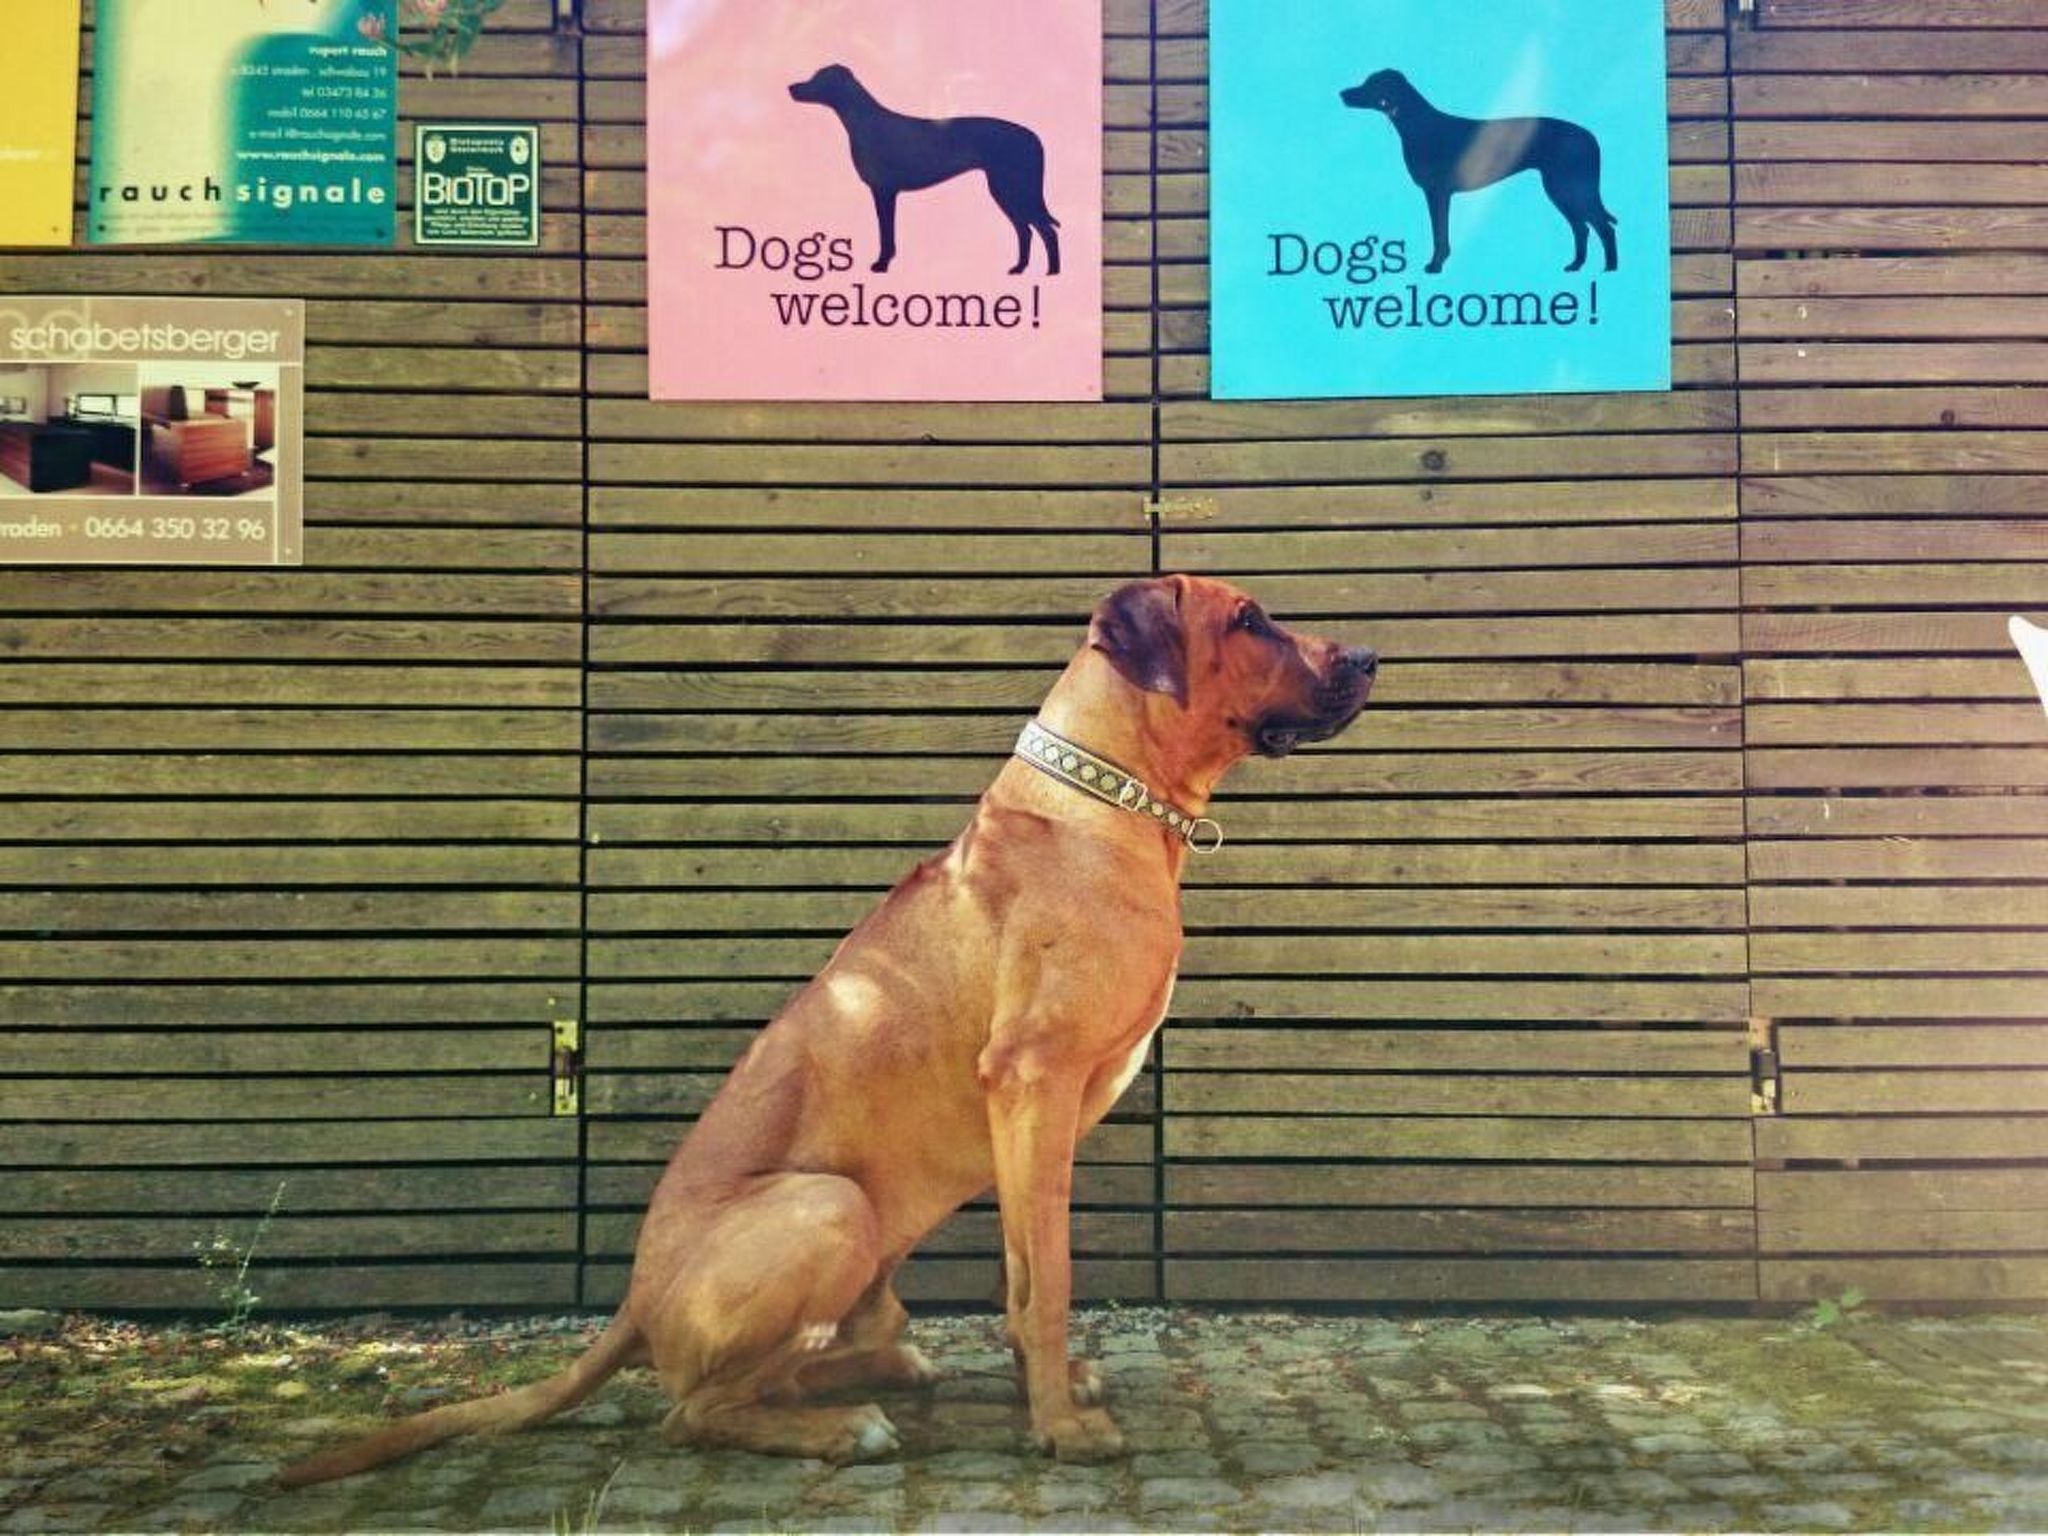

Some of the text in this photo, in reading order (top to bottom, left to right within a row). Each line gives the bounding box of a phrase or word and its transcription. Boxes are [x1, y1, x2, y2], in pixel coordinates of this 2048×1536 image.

[352, 46, 388, 57] rauch
[300, 107, 328, 119] 0664
[99, 176, 386, 208] rauch signale
[714, 225, 855, 281] Dogs
[1266, 232, 1407, 285] Dogs
[770, 283, 1041, 329] welcome!
[1322, 280, 1599, 329] welcome!
[9, 321, 281, 359] schabetsberger
[0, 513, 267, 541] raden 0664 350 32 96
